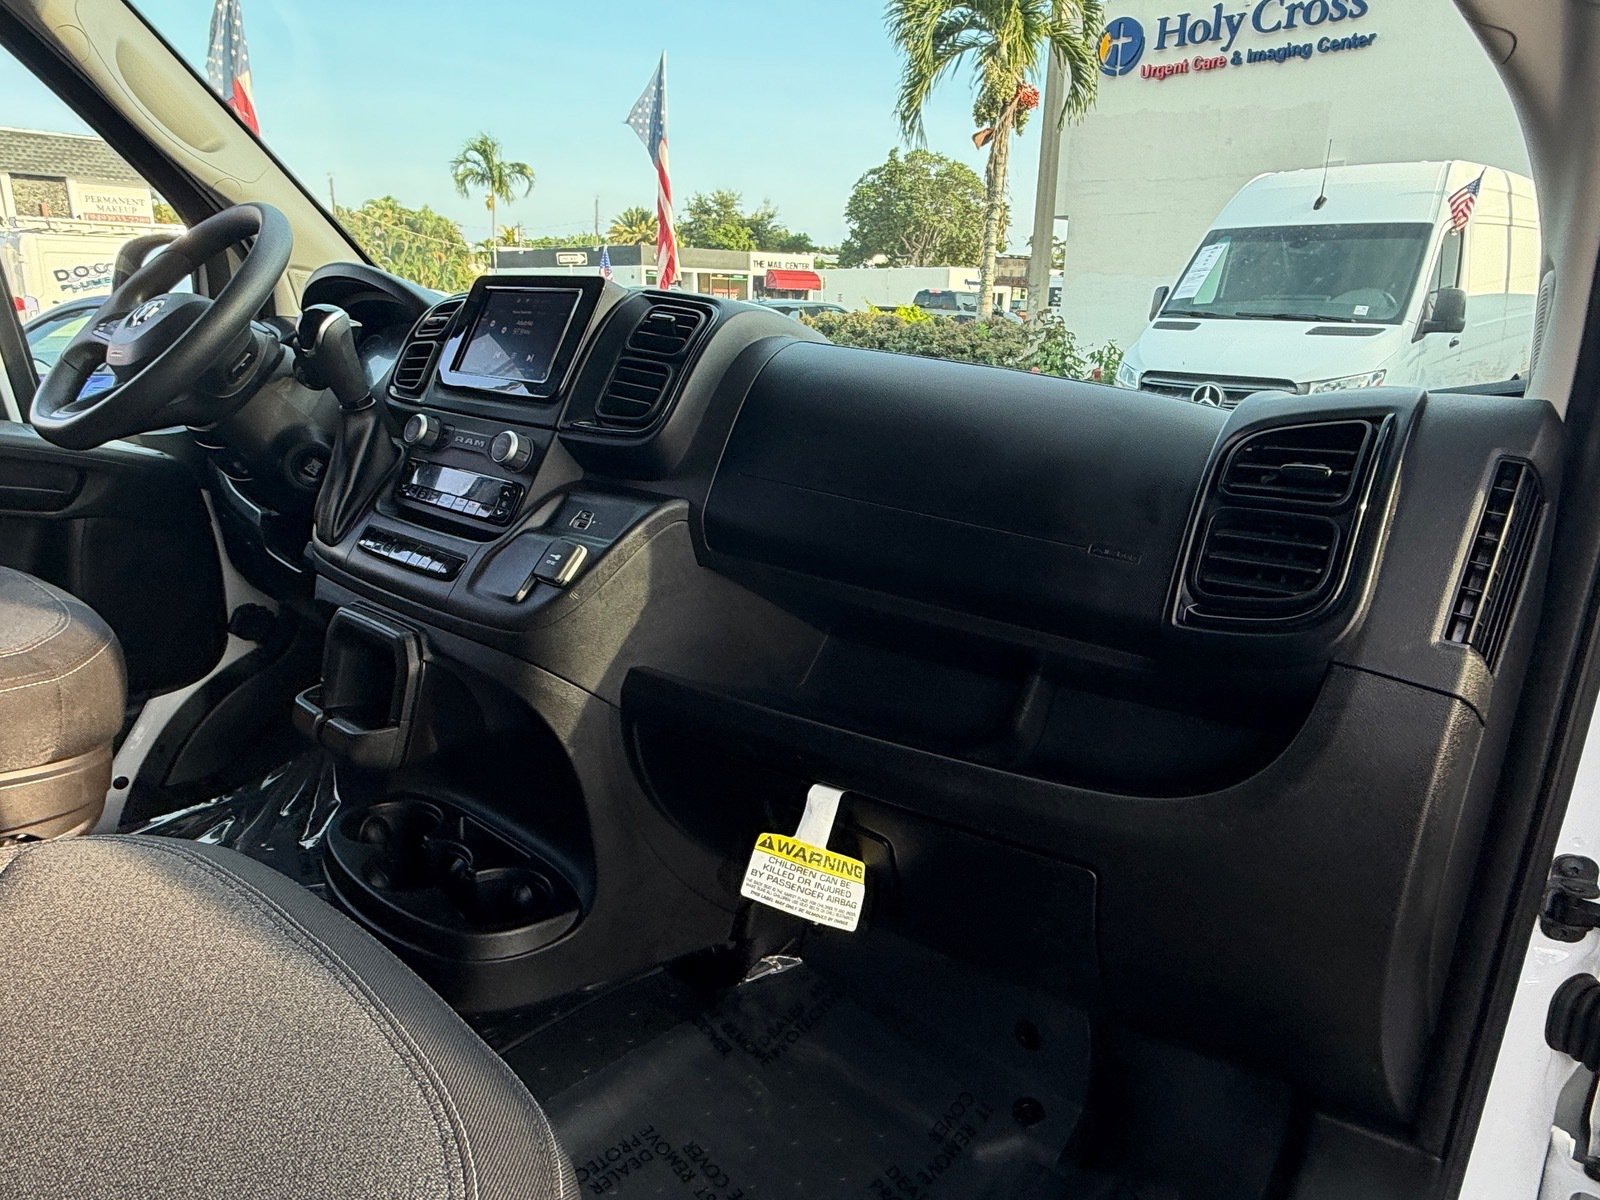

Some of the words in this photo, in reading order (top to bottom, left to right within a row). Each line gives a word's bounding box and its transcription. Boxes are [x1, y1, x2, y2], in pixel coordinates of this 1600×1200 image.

[1154, 3, 1247, 51] Holy
[1252, 0, 1369, 33] Cross
[1140, 55, 1189, 80] Urgent
[1192, 54, 1227, 71] Care
[1230, 50, 1243, 66] &
[1247, 42, 1313, 63] Imaging
[1317, 32, 1377, 54] Center
[85, 195, 145, 206] PERMANENT
[96, 204, 138, 214] MAKEUP
[753, 260, 765, 268] THE
[768, 261, 782, 269] MAIL
[455, 436, 486, 448] RAM
[768, 856, 817, 879] CHILDREN
[820, 874, 838, 886] CAN
[840, 880, 851, 889] BE
[777, 839, 864, 879] WARNING
[751, 869, 764, 878] BY
[766, 874, 824, 901] PASSENGER
[826, 895, 857, 909] AIRBAG
[763, 863, 795, 881] KILLED
[797, 875, 811, 886] OR
[814, 881, 852, 898] INJURED
[588, 1149, 654, 1195] DEALER
[639, 1124, 696, 1184] REMOVE
[683, 1139, 730, 1189] COVER
